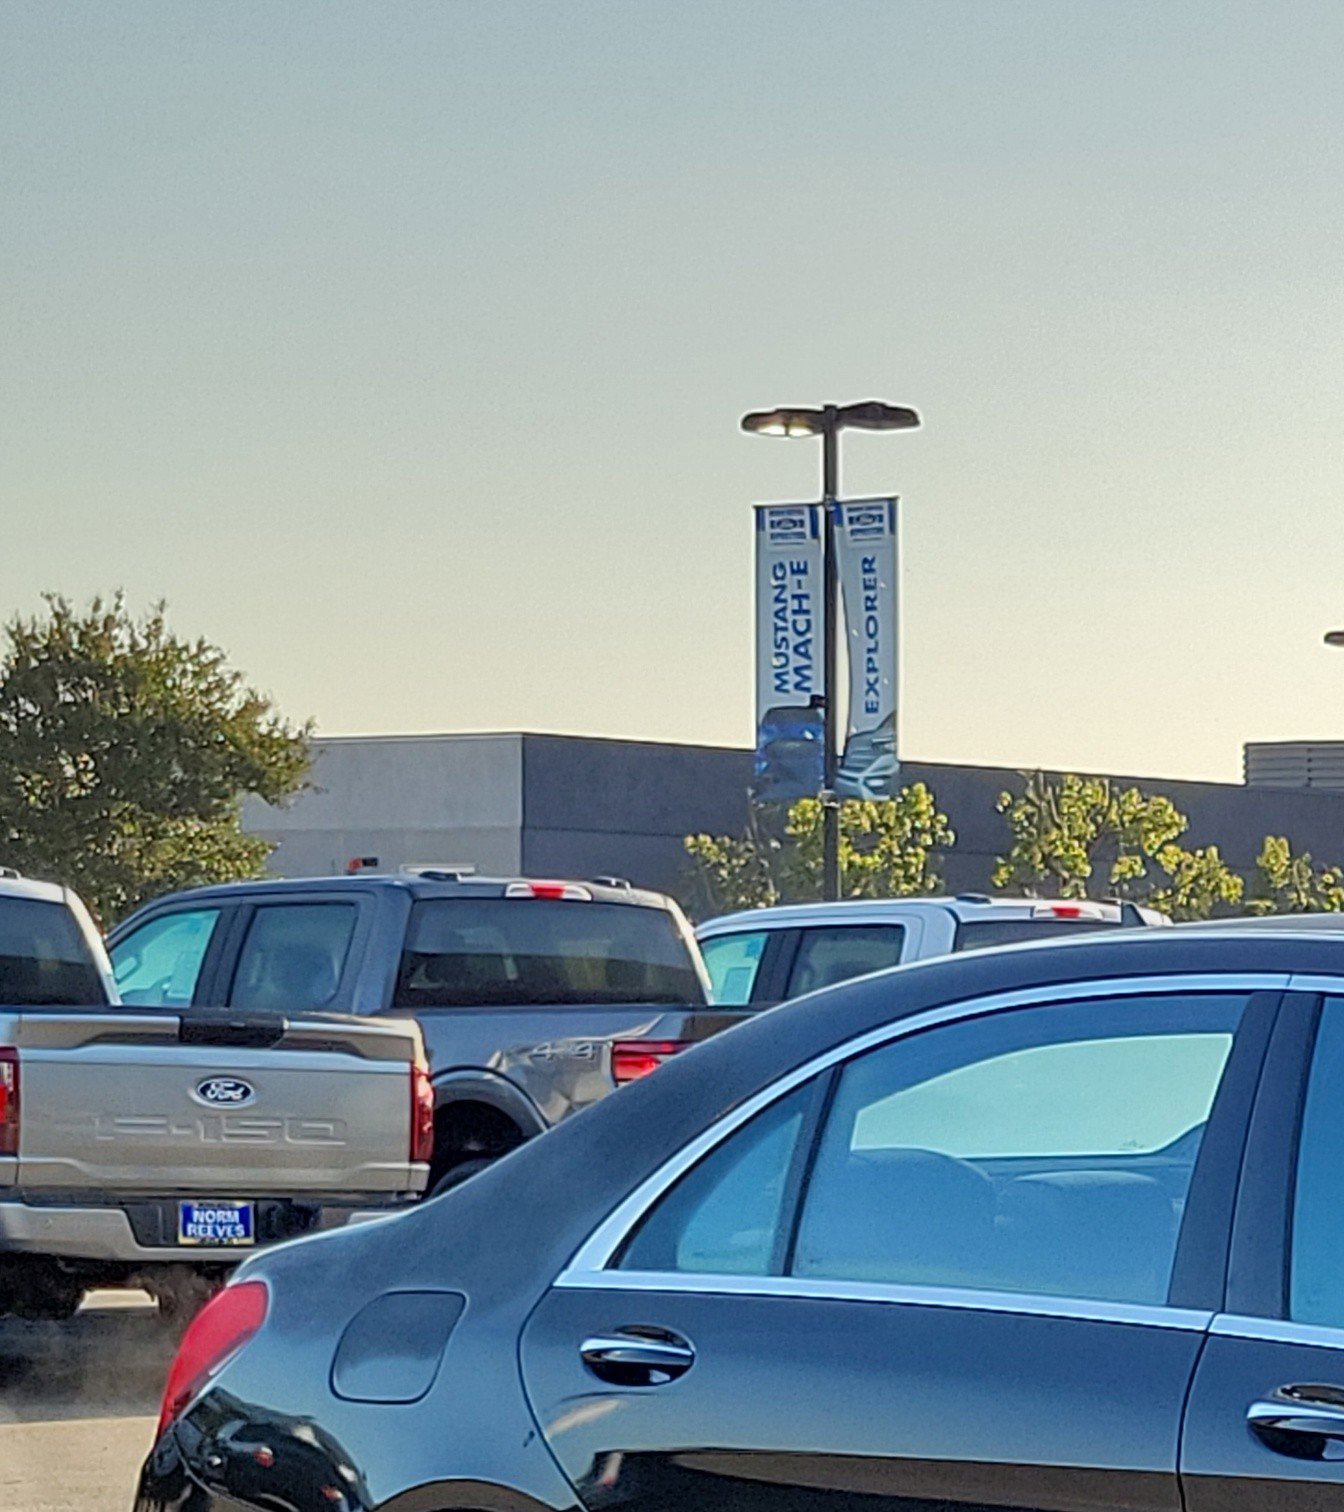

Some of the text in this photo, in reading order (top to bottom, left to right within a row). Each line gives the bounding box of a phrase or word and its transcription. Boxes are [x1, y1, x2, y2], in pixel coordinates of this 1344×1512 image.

[772, 562, 789, 694] MUSTANG
[789, 560, 812, 693] MACH-E
[862, 556, 880, 715] EXPLORER
[95, 1114, 348, 1146] F-150
[186, 1223, 245, 1238] REEVES
[193, 1210, 240, 1223] NORM
